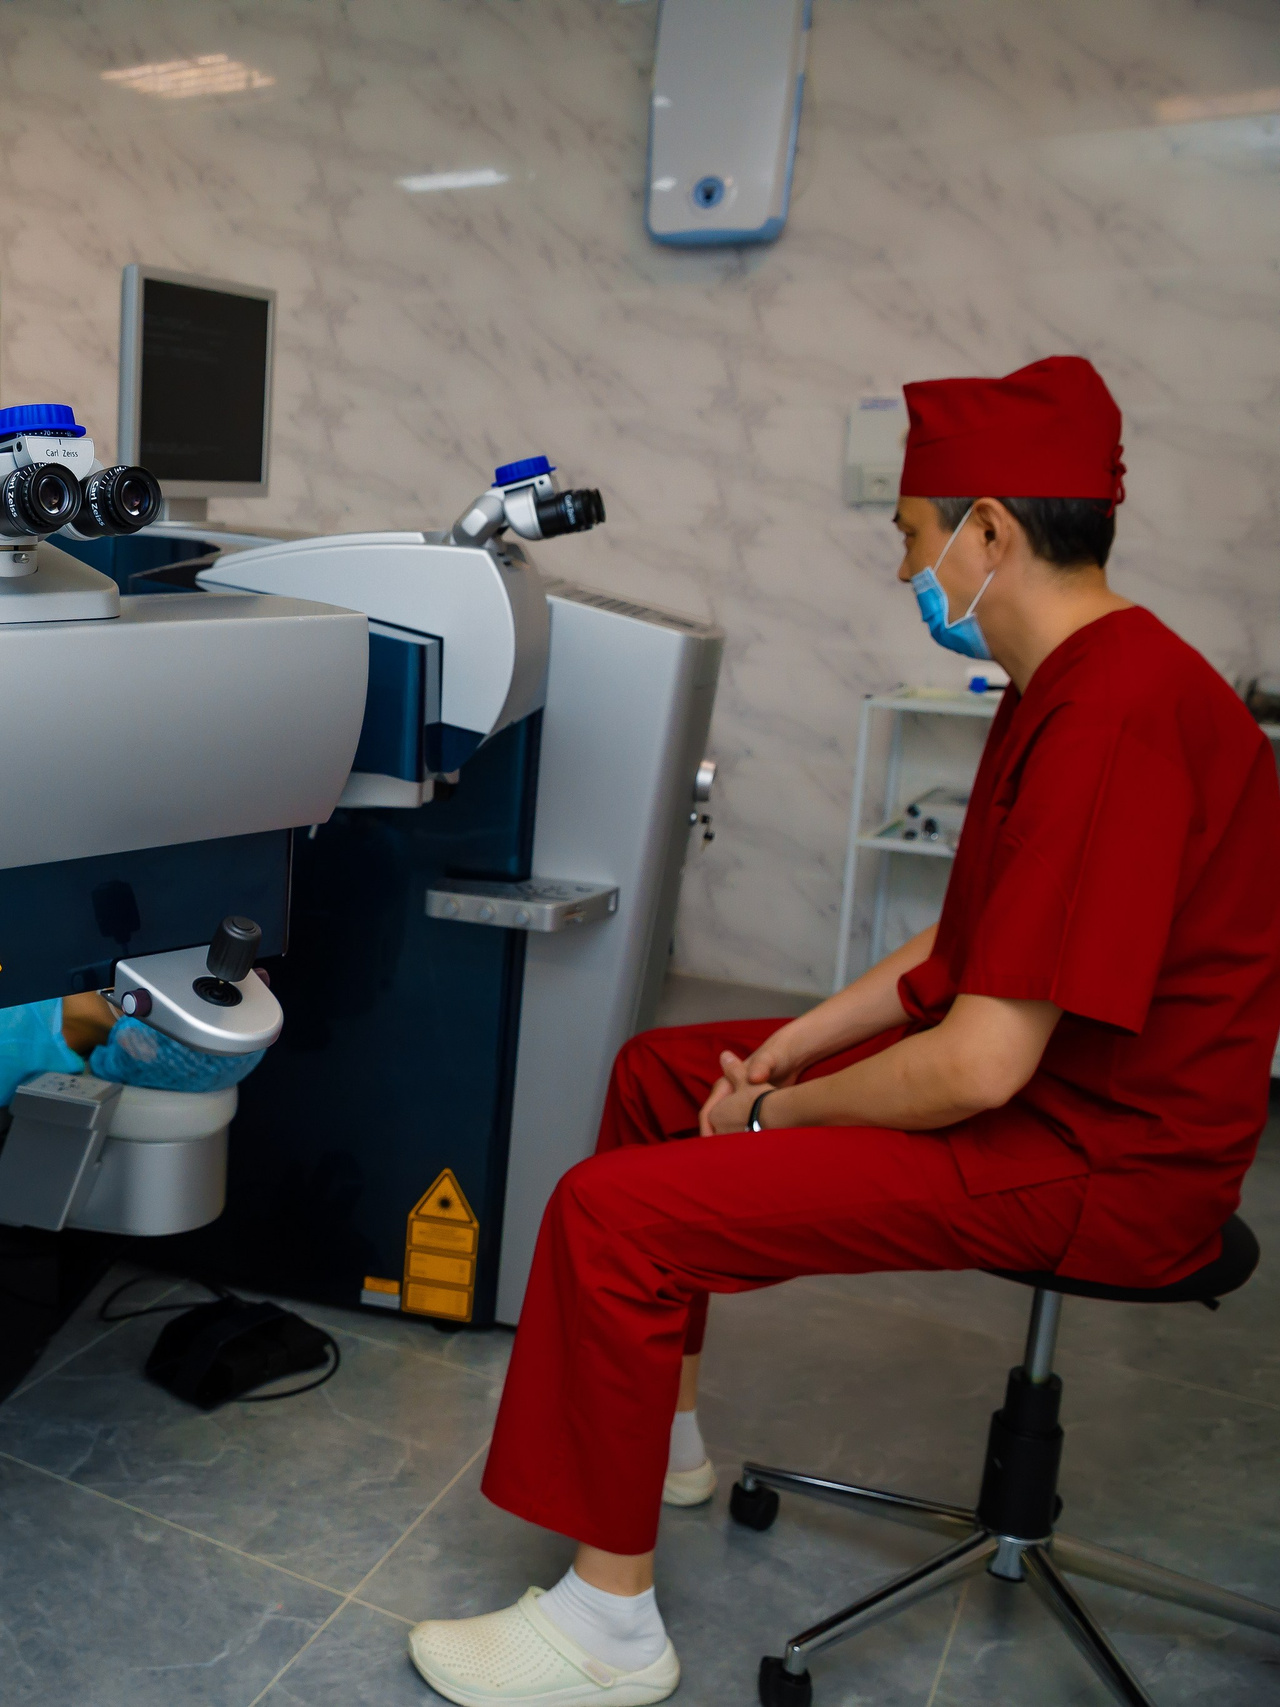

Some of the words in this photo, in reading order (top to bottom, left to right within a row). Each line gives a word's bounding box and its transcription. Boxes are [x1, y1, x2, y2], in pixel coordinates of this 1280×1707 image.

[45, 448, 60, 458] Carl
[62, 449, 79, 458] Zeiss
[8, 471, 21, 489] Carl
[90, 481, 99, 500] Carl
[7, 491, 18, 518] Zeiss
[91, 503, 106, 527] Zeiss
